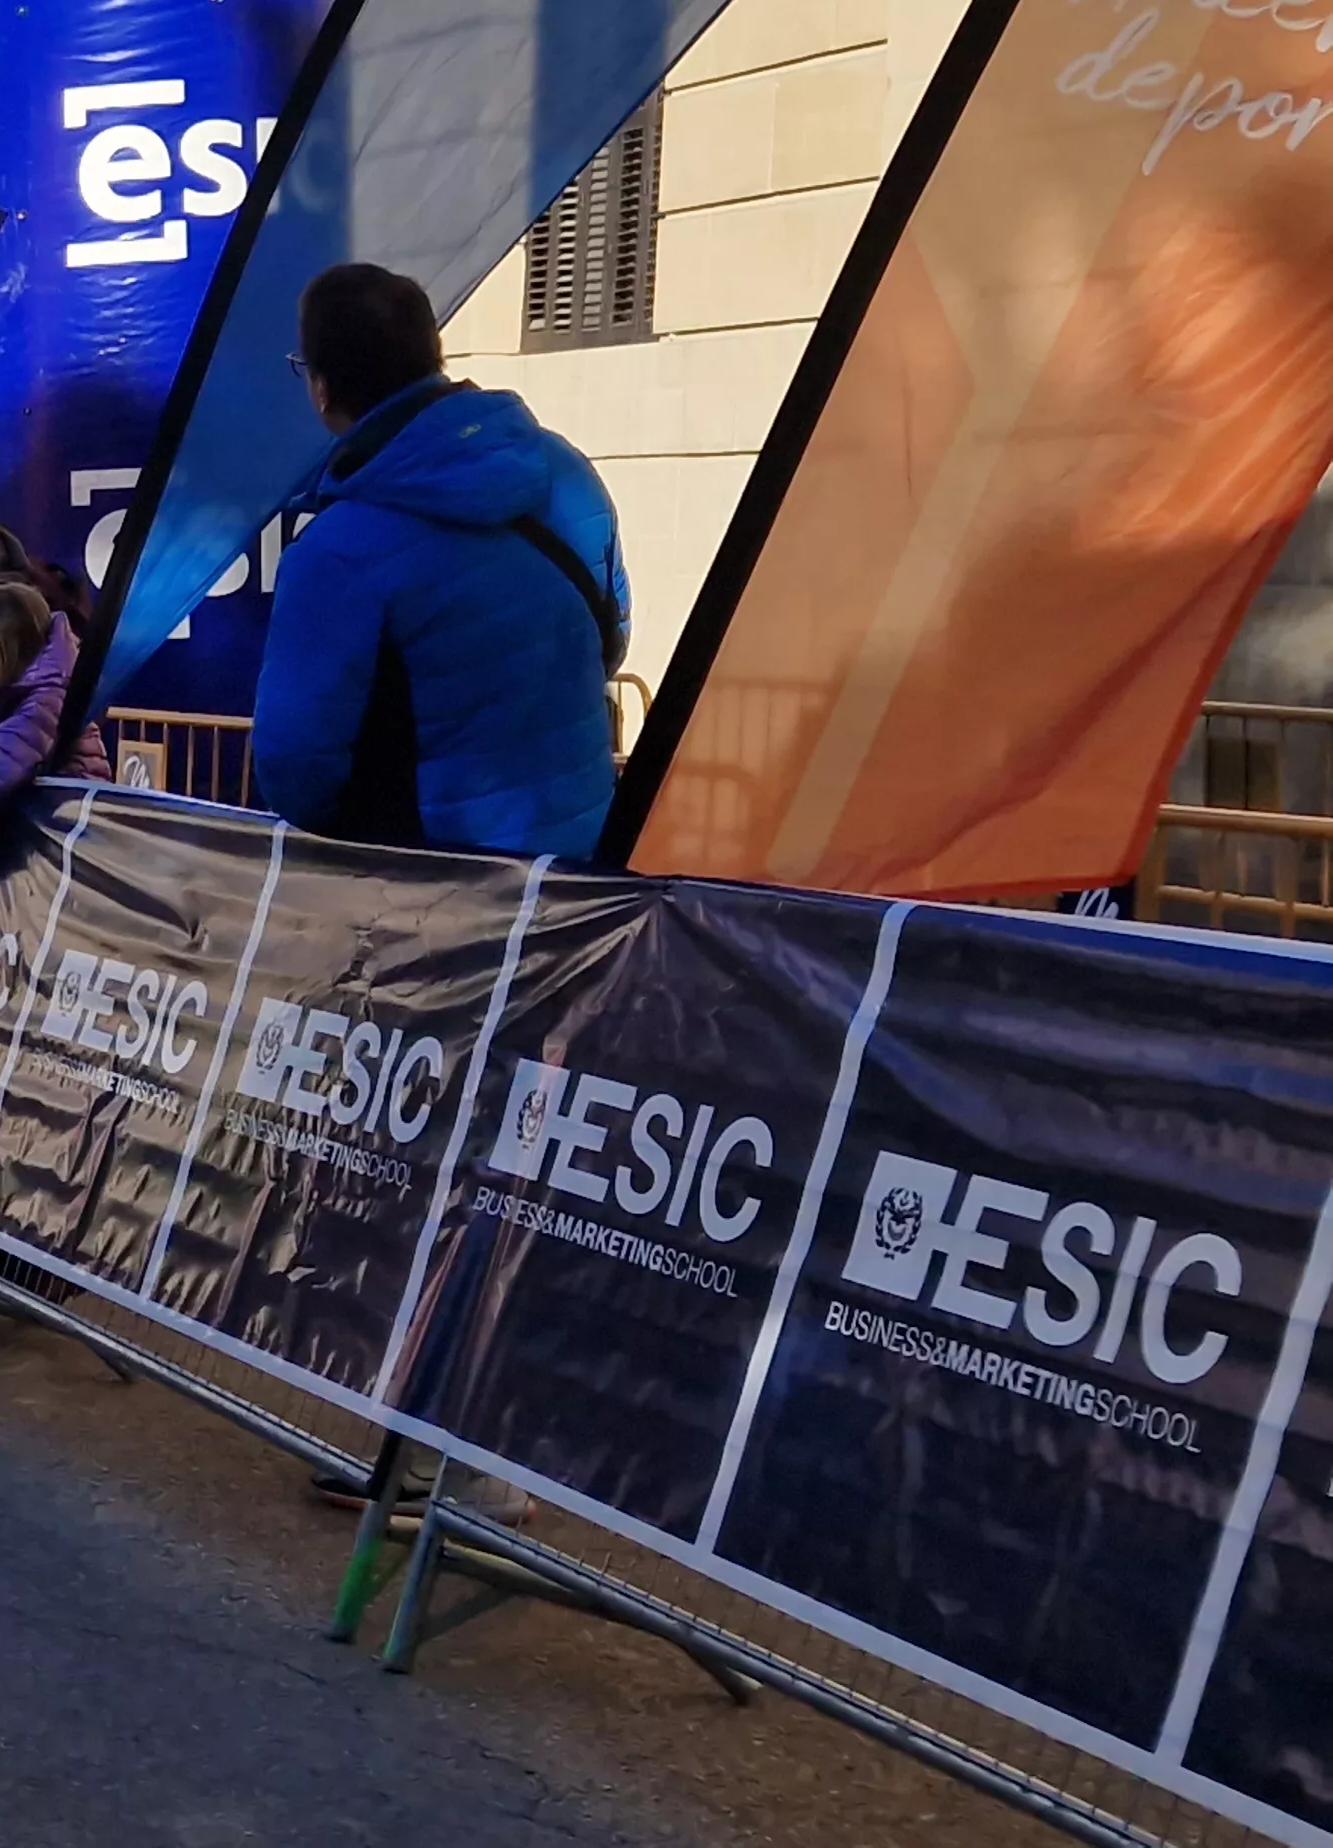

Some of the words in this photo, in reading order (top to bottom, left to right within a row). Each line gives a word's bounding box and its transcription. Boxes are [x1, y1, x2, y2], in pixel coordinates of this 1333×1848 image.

[77, 957, 208, 1074] ESIC
[281, 1008, 443, 1143] ESIC
[546, 1072, 774, 1243] ESIC
[930, 1173, 1243, 1385] ESIC
[823, 1300, 1202, 1454] BUSINESS&MARKETINGSCHOOL
